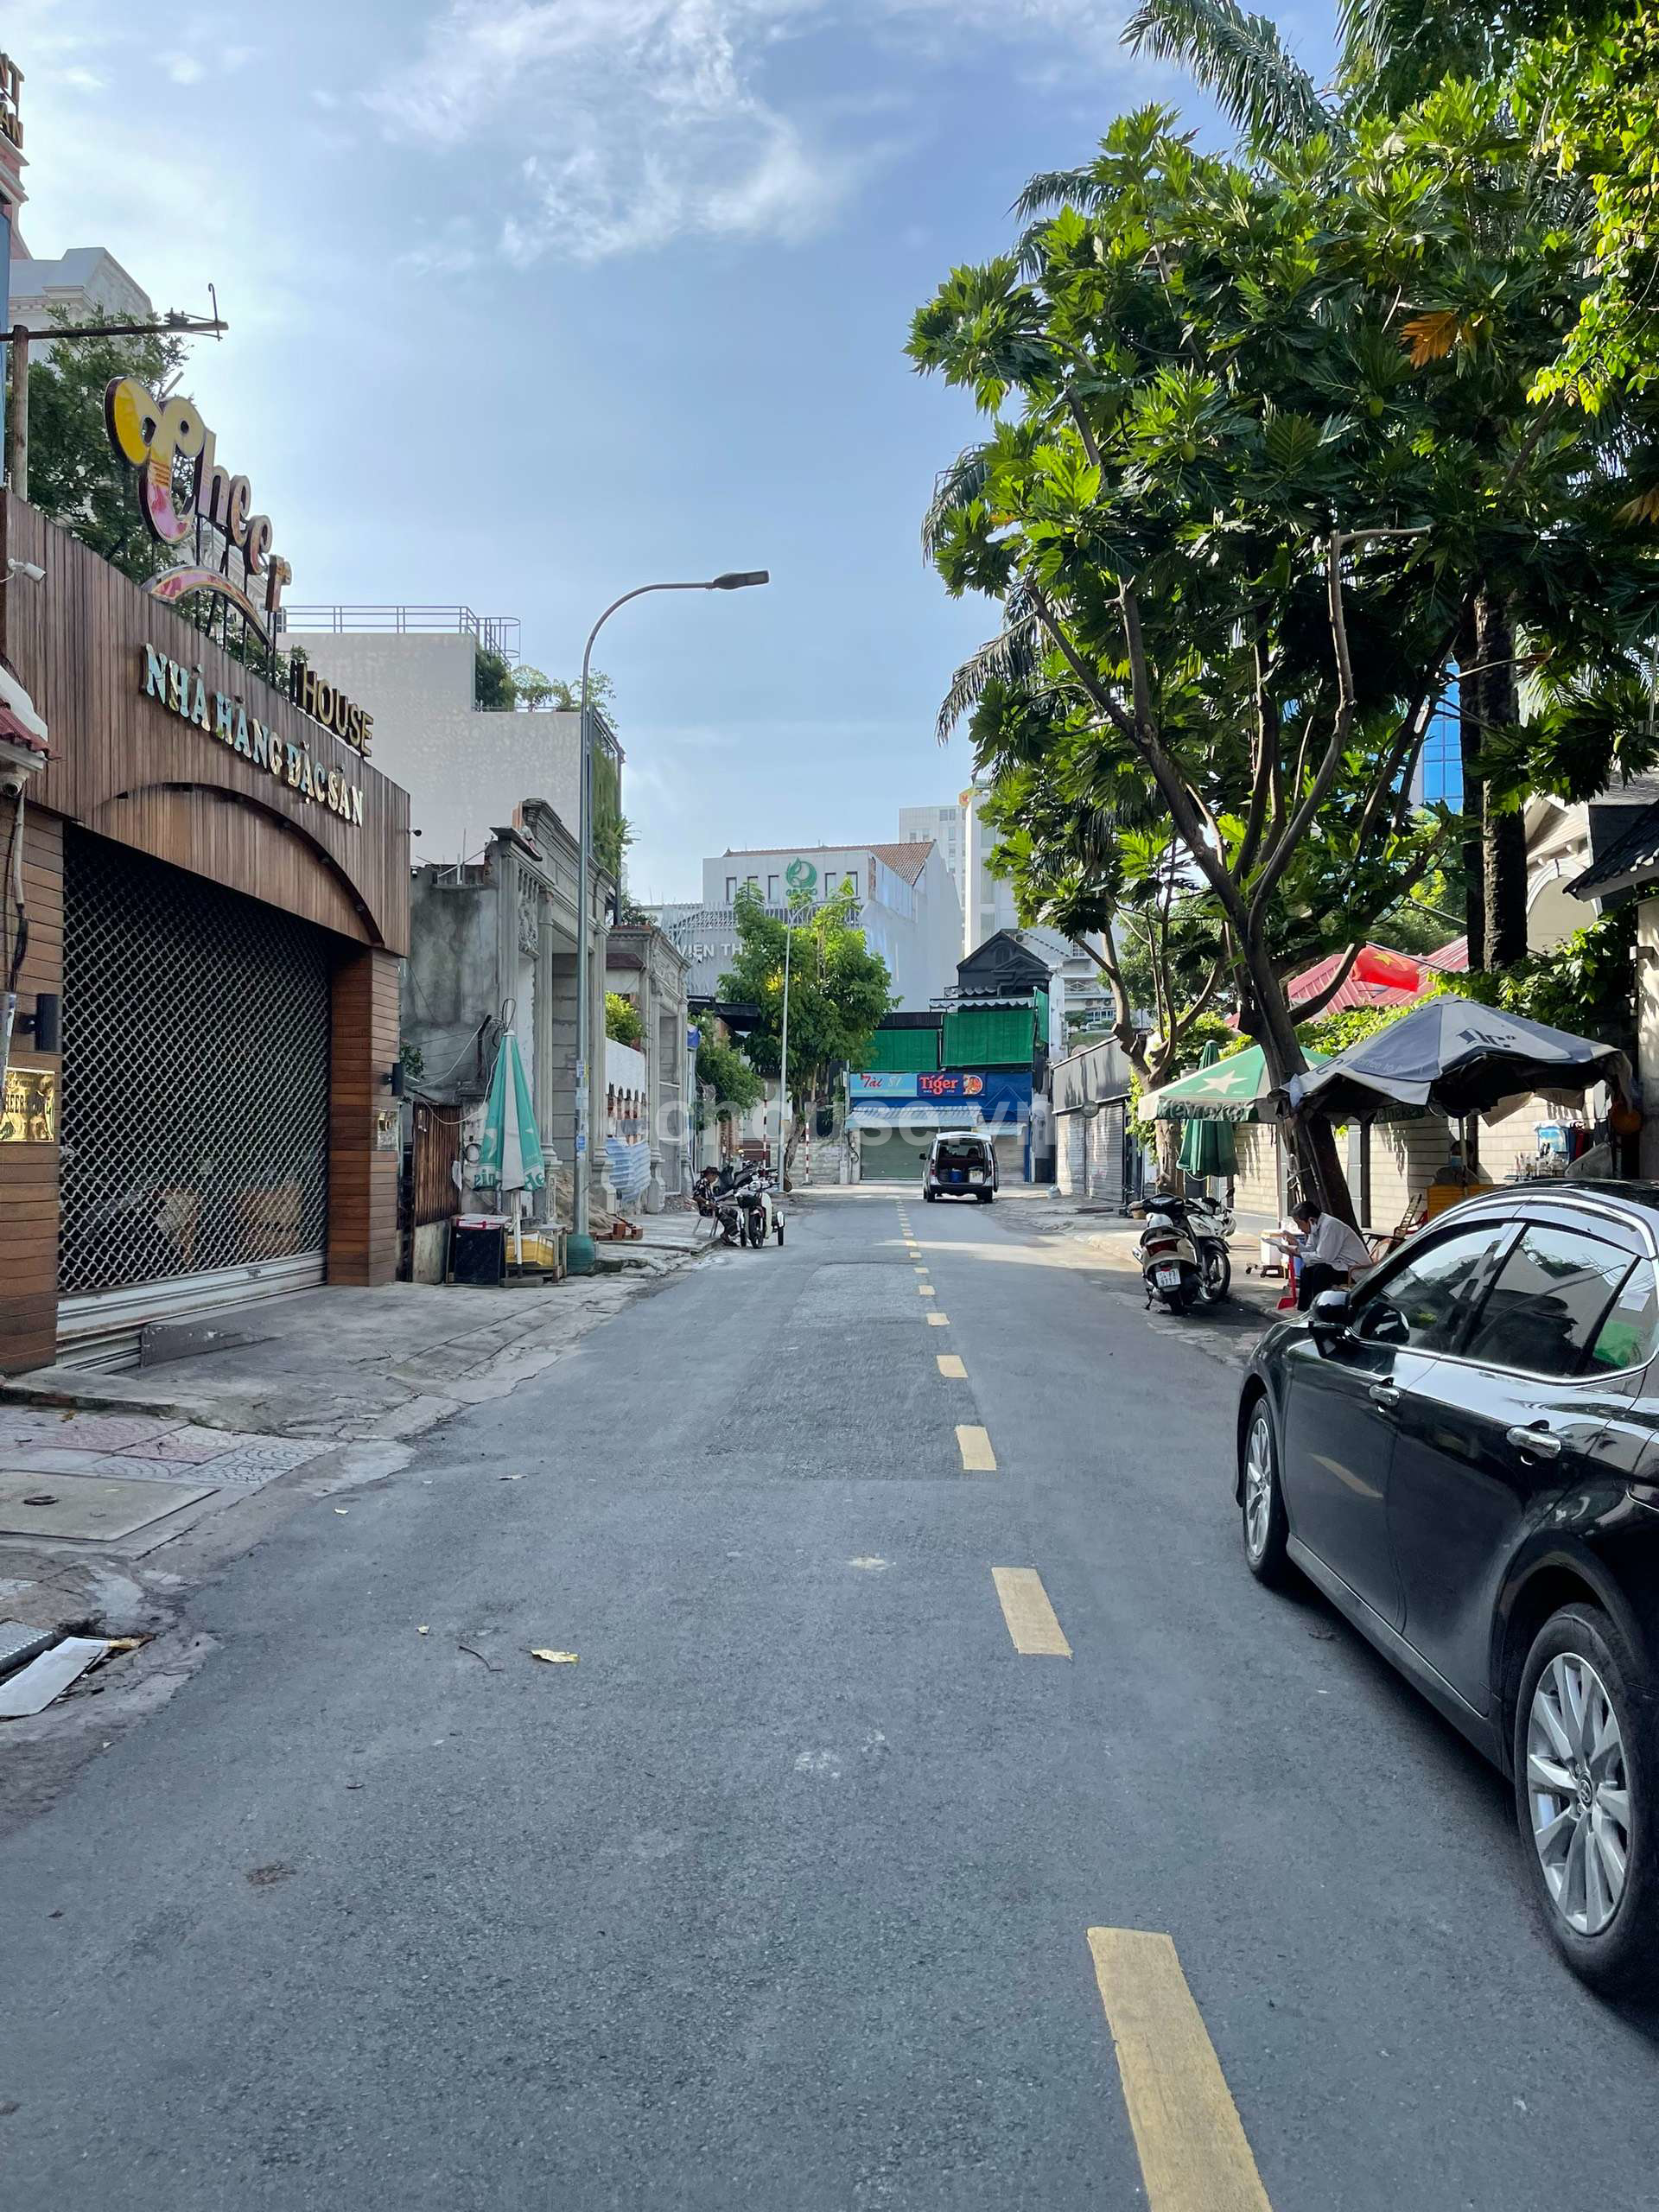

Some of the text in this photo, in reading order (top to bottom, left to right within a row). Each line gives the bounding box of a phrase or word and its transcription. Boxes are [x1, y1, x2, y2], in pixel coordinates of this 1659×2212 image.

[145, 643, 211, 732] NHÀ
[216, 691, 283, 775] HÀNG
[300, 661, 373, 757] HOUSE
[919, 1074, 958, 1095] Tiger
